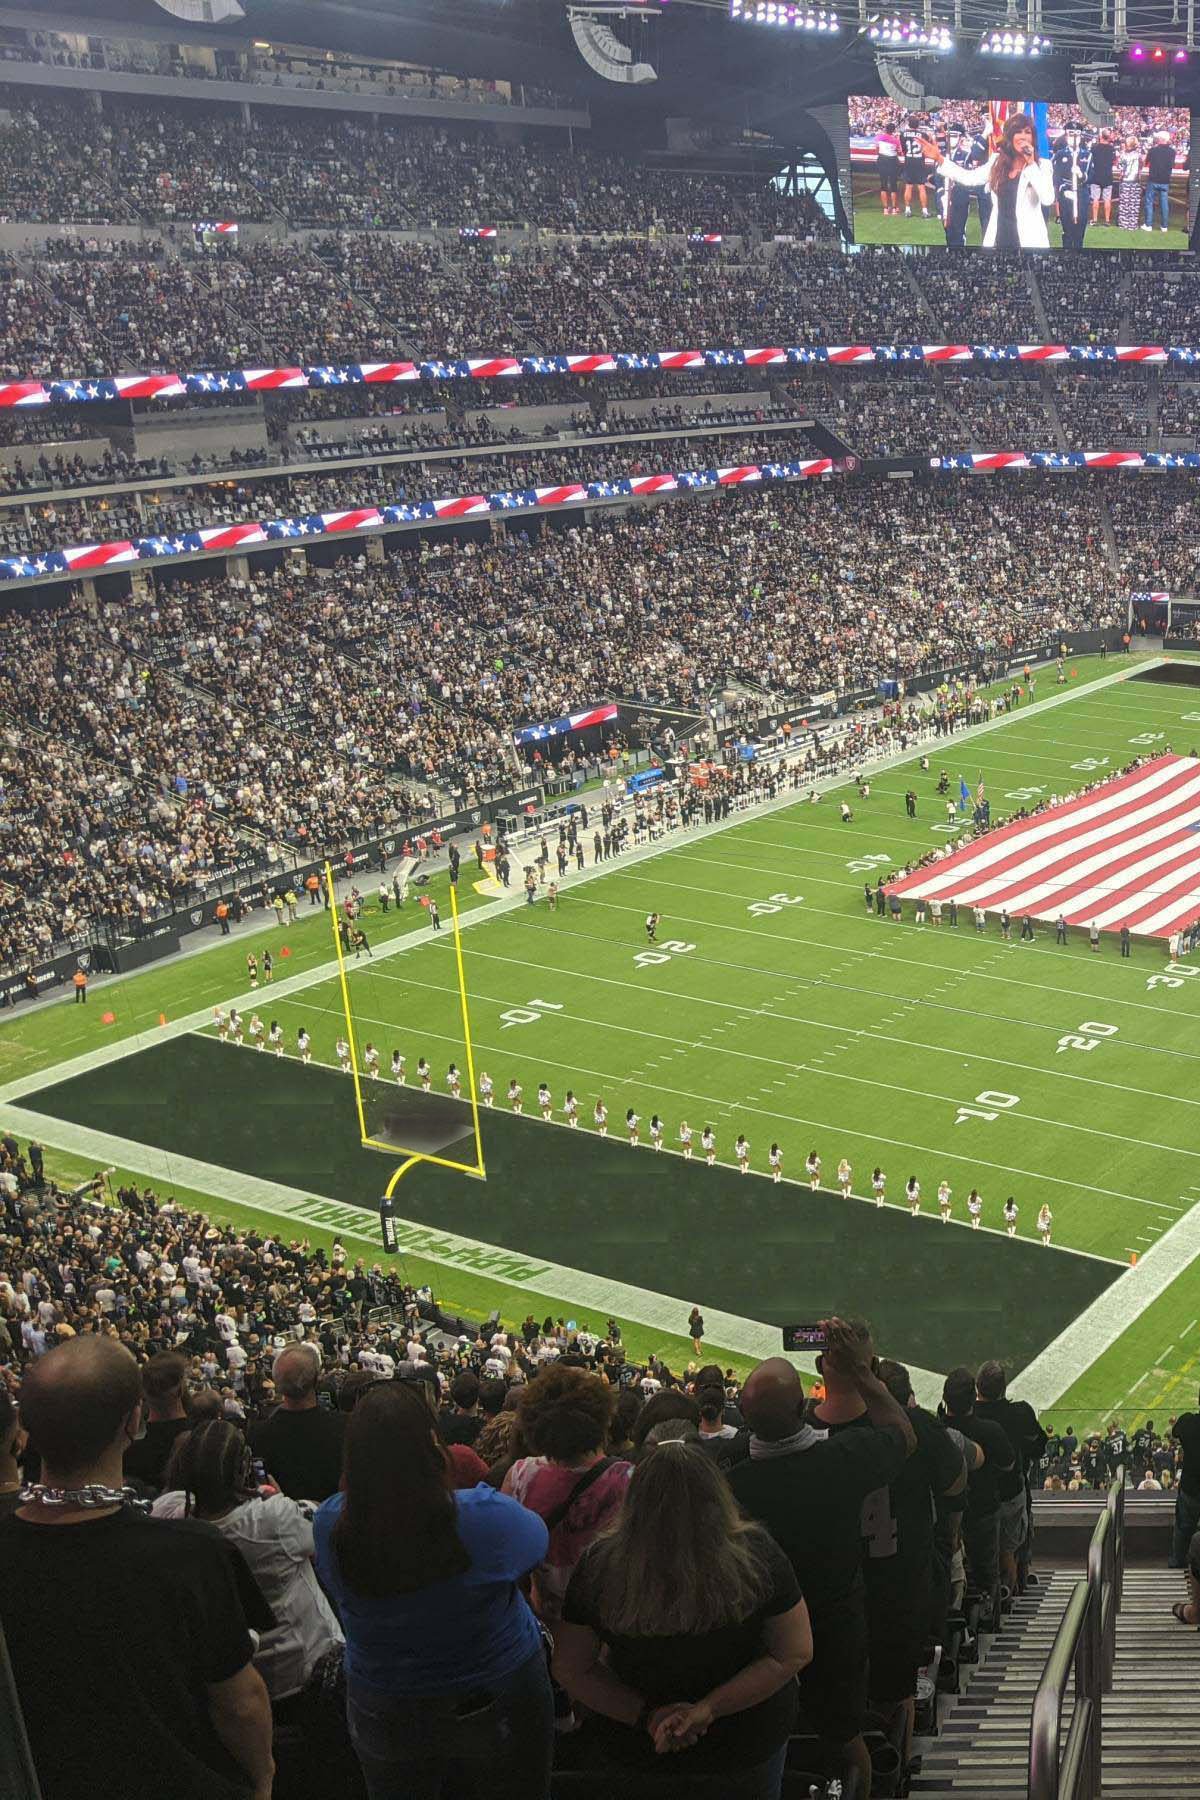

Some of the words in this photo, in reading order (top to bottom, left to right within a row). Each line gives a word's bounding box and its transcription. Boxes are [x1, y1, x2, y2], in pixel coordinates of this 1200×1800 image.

[905, 140, 922, 158] 12
[1128, 732, 1160, 745] 20
[1070, 757, 1104, 771] 30
[845, 854, 892, 871] 40
[747, 893, 804, 914] 30
[632, 940, 697, 965] 20
[500, 999, 564, 1024] 10
[1057, 1021, 1120, 1051] 20
[956, 1090, 1021, 1121] 10
